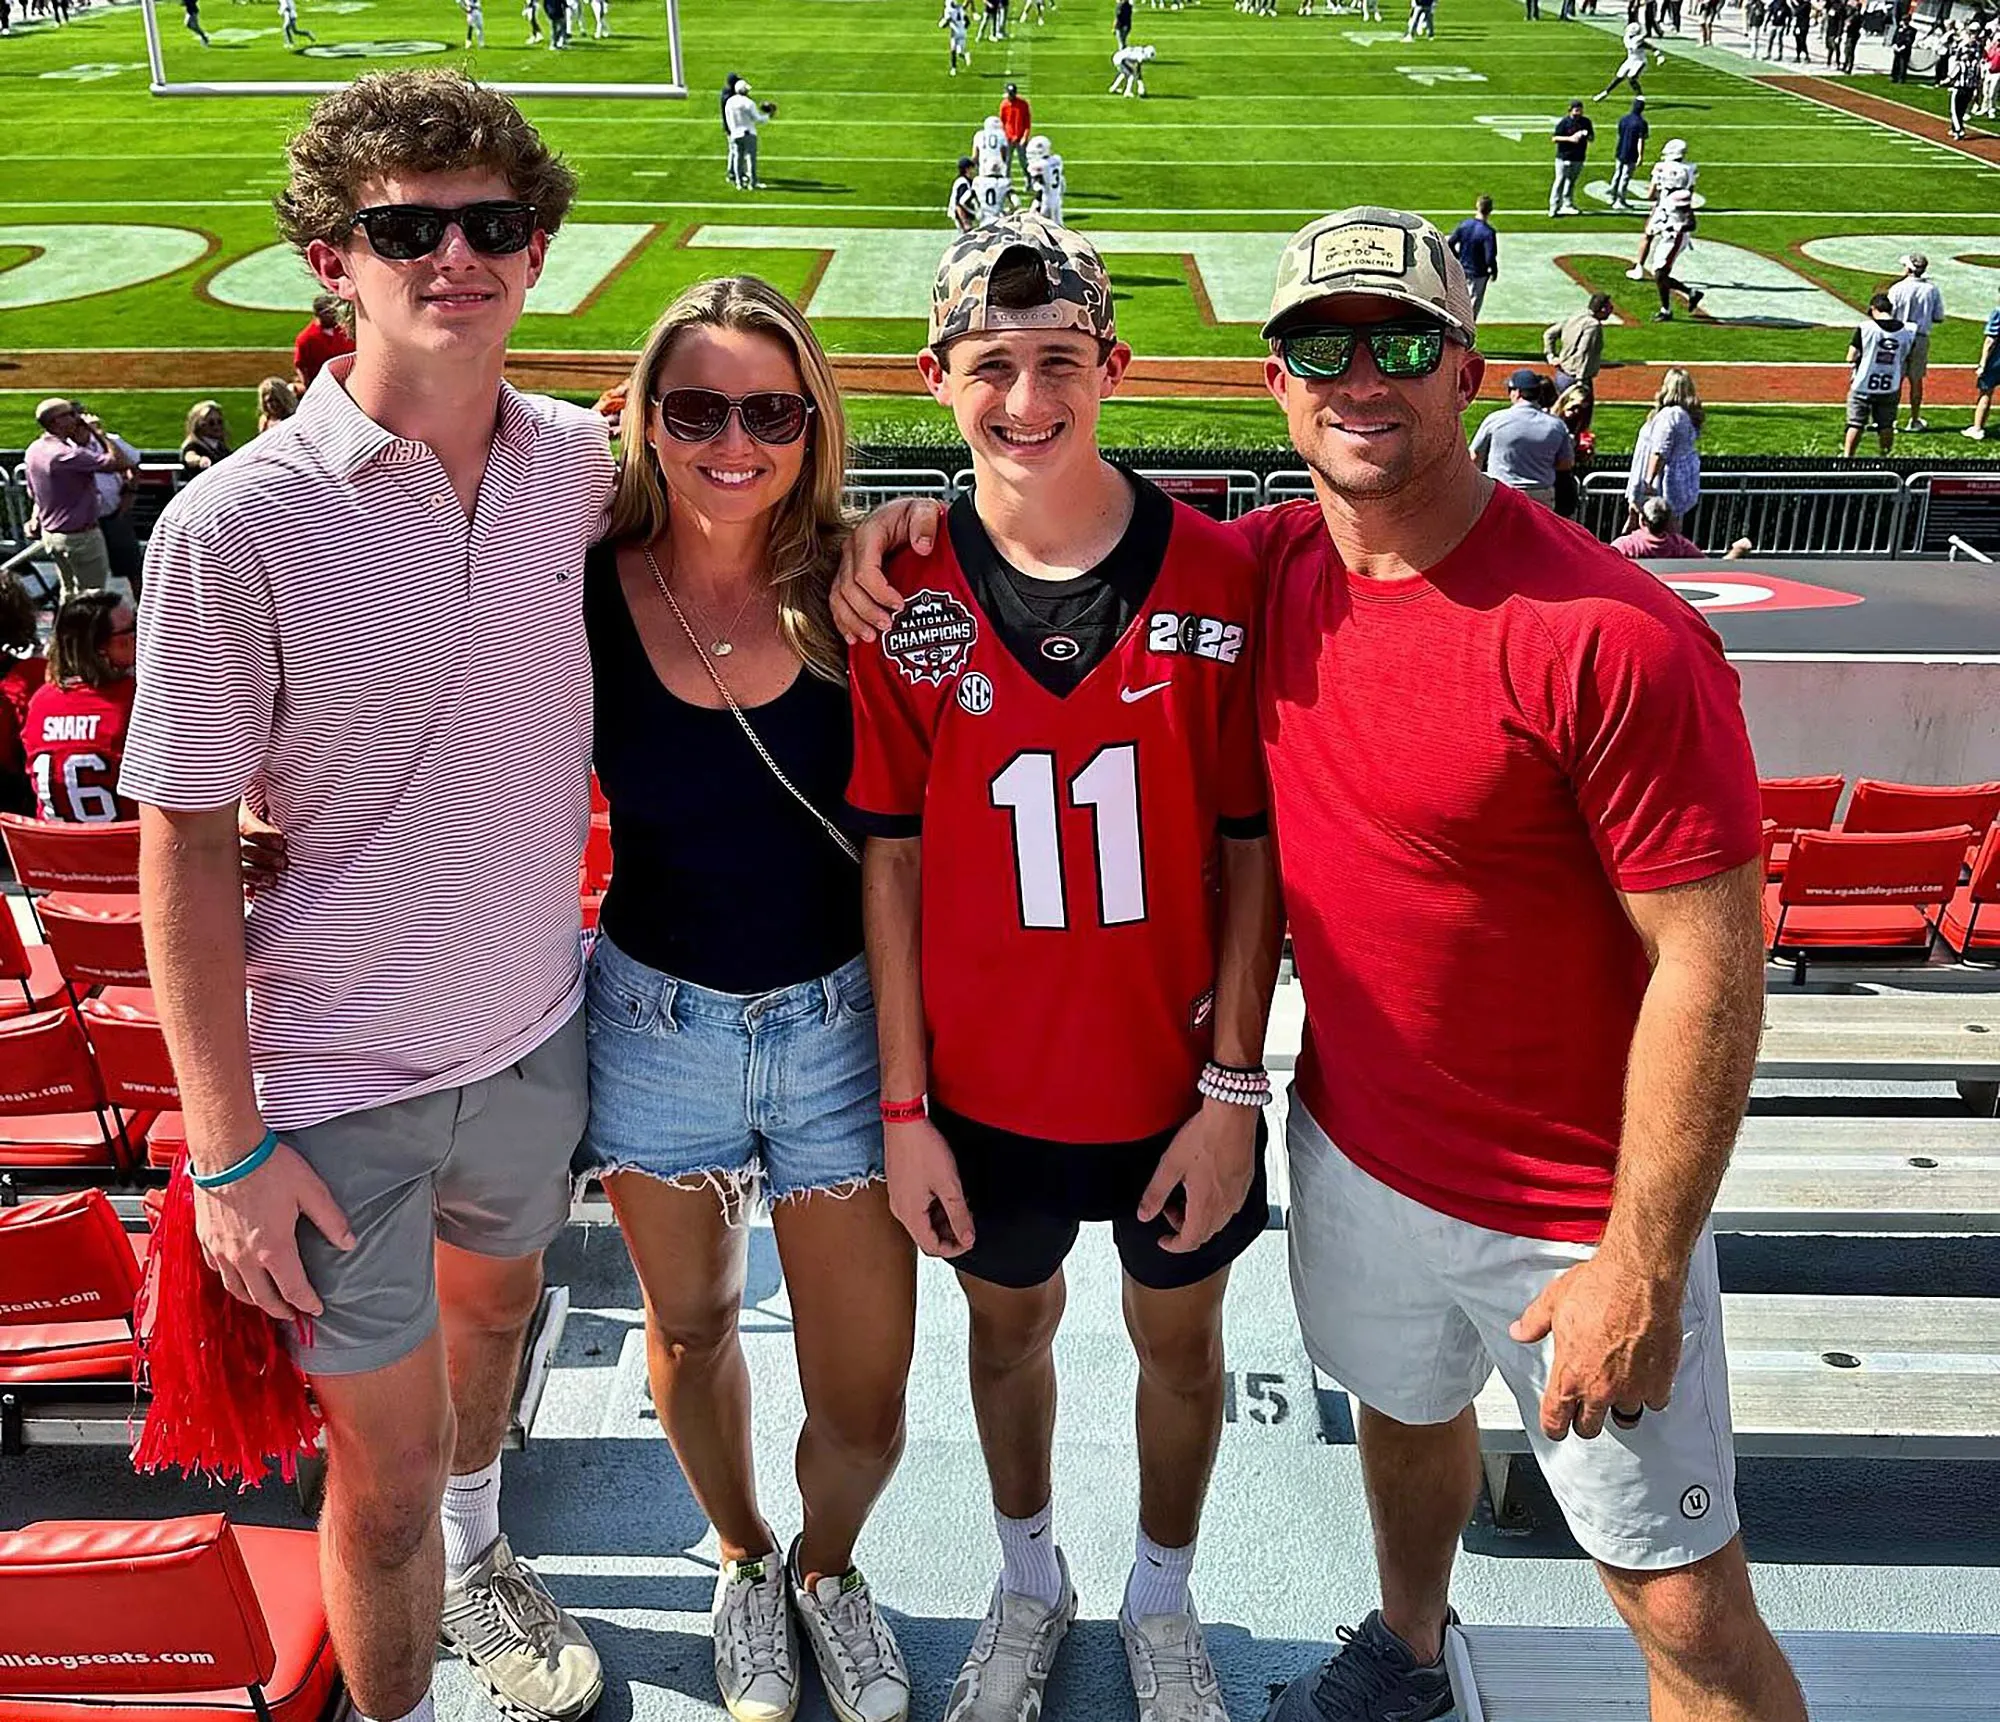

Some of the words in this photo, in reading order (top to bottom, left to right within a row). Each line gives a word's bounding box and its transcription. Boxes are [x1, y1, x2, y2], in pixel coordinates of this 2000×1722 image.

[1051, 168, 1060, 189] 3
[985, 188, 997, 206] 0
[1354, 258, 1394, 268] CONCRETE
[1867, 373, 1894, 391] 66
[901, 613, 956, 629] NATIONAL
[889, 622, 971, 651] CHAMPIONS
[960, 675, 990, 712] SEC
[42, 714, 101, 741] SMART
[32, 752, 118, 823] 16
[990, 743, 1147, 929] 11
[0, 1290, 101, 1315] seats.com
[1224, 1371, 1290, 1425] 15
